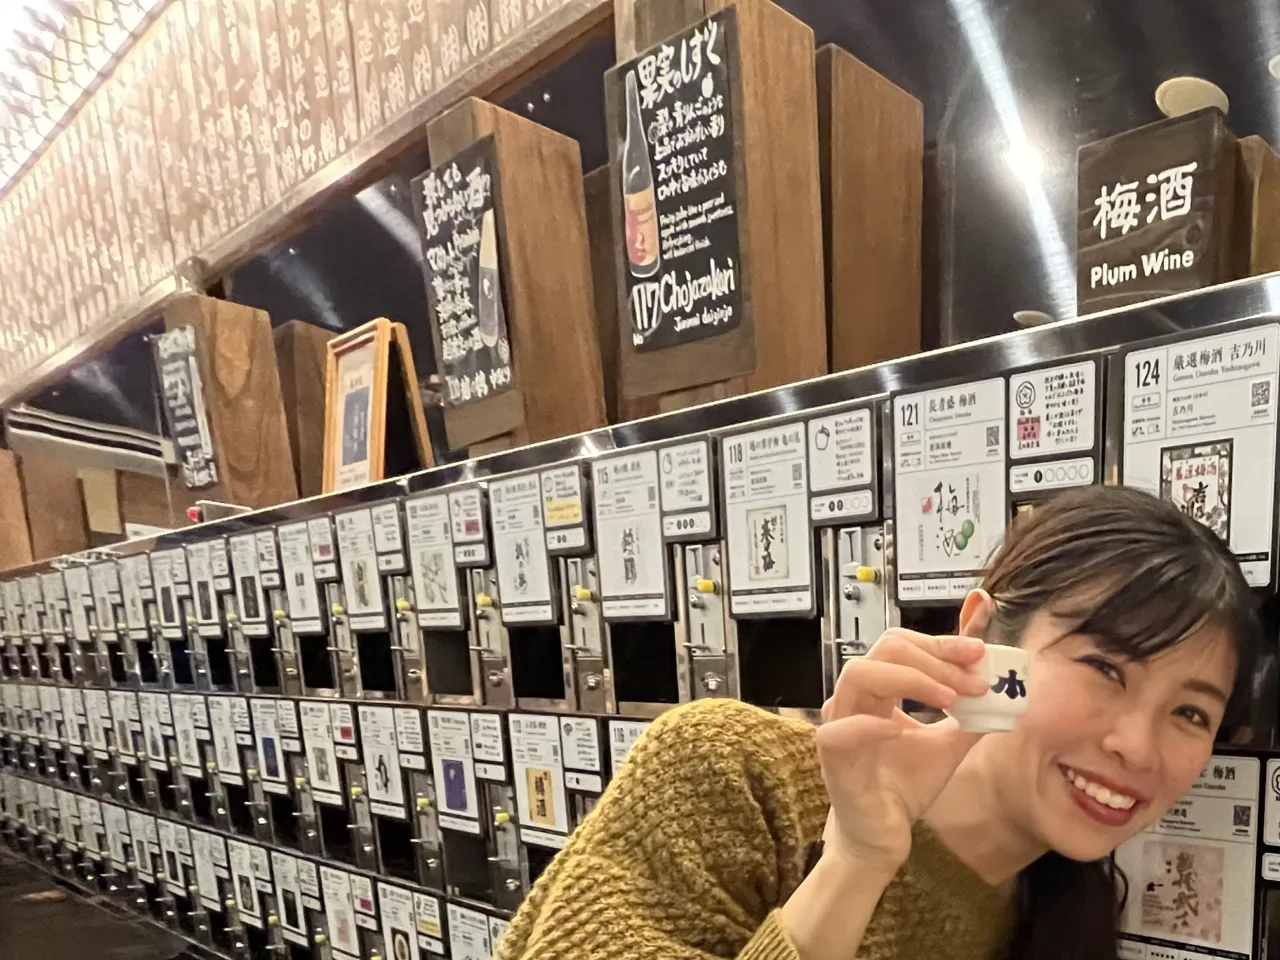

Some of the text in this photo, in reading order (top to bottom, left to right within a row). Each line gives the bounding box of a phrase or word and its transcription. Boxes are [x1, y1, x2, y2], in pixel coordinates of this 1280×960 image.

[1092, 161, 1198, 240] 梅酒
[1090, 248, 1195, 289] Plum Wine
[1229, 337, 1267, 360] 吉乃川
[1135, 359, 1161, 388] 124
[901, 403, 919, 427] 121
[729, 443, 743, 464] 118
[1212, 765, 1236, 780] 梅酒
